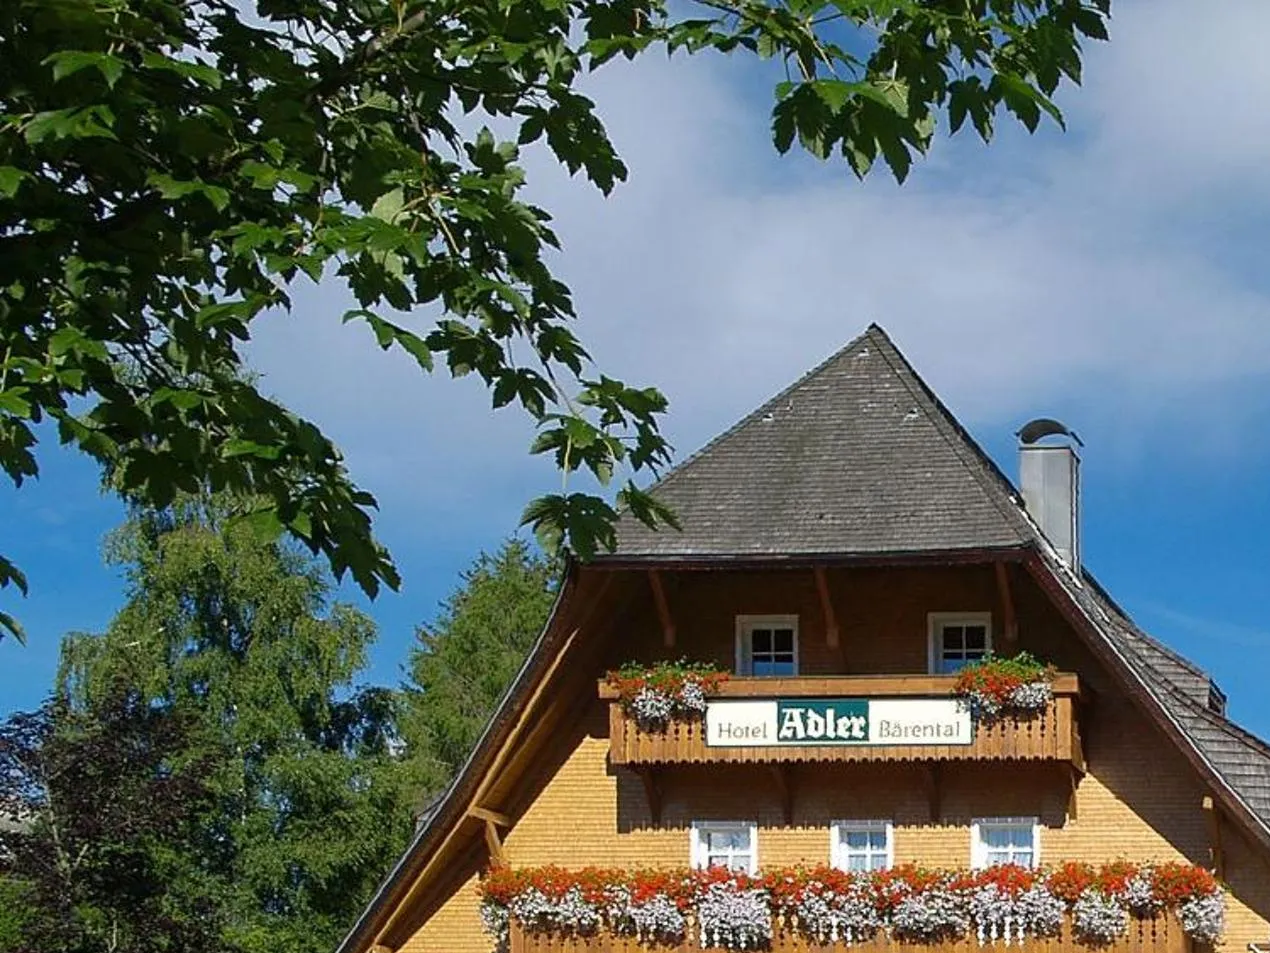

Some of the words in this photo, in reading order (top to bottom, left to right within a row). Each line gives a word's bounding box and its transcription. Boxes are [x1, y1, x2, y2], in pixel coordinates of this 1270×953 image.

[718, 721, 768, 740] Hotel
[778, 706, 866, 740] Adler
[878, 719, 961, 739] Bärental
